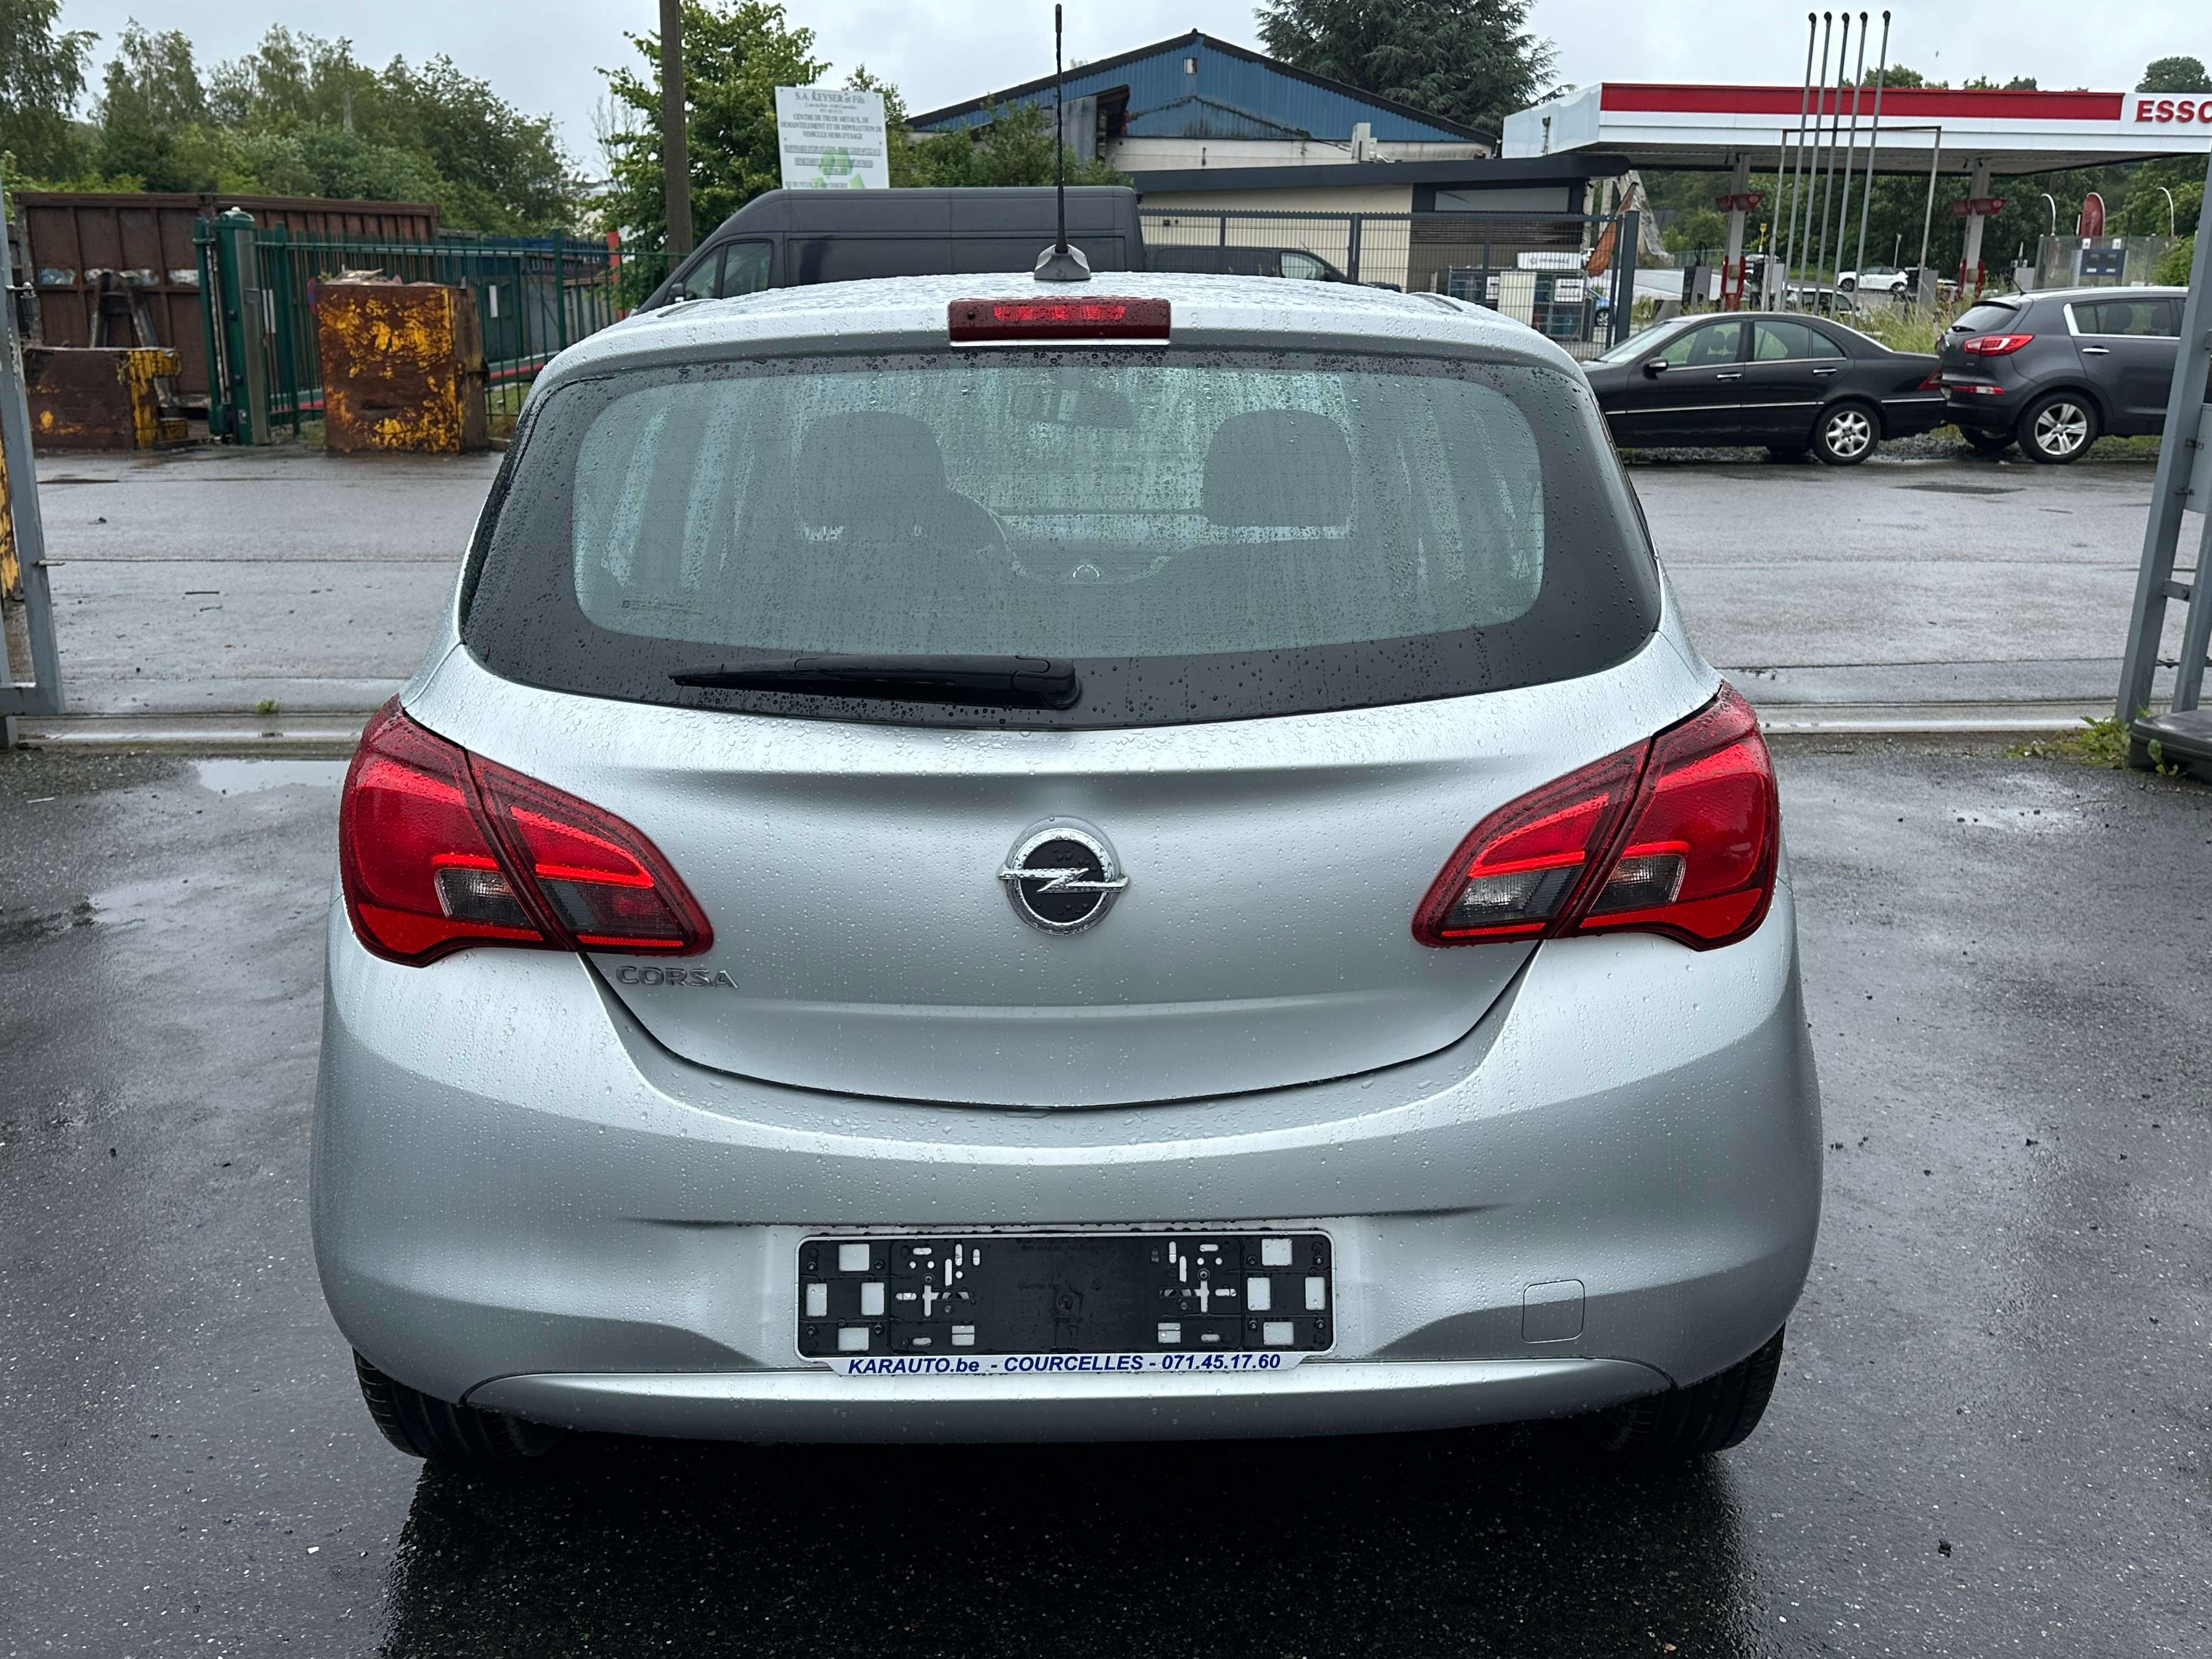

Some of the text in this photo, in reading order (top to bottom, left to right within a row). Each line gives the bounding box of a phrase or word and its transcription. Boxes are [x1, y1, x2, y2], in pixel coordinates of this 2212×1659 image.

[812, 92, 843, 103] KEYSER
[2135, 100, 2212, 123] ESSO
[616, 966, 740, 989] CORSA
[848, 1358, 979, 1374] KARAUTO.be
[1004, 1355, 1143, 1372] COURCELLES
[1162, 1354, 1281, 1369] 071.45.17.60
